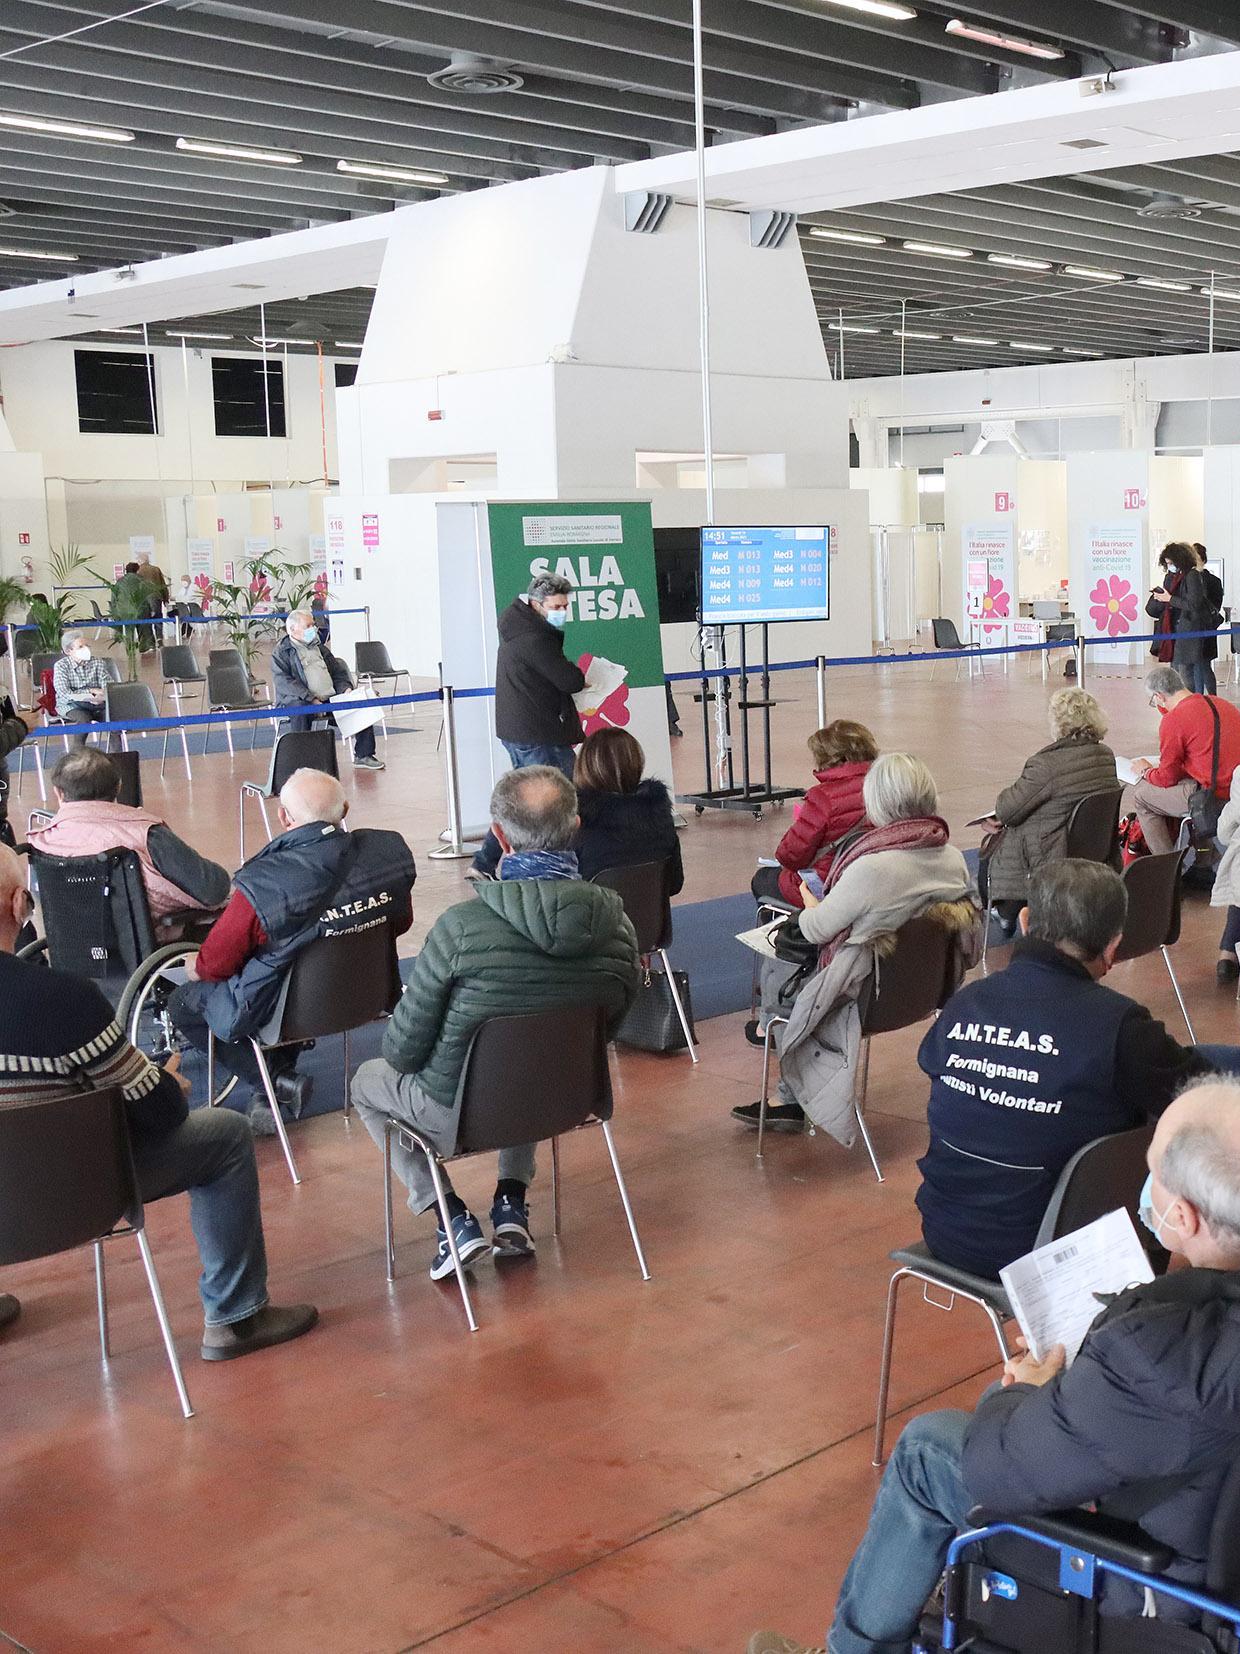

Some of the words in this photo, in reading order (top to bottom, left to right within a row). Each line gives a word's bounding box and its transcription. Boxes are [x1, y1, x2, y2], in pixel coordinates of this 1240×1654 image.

[999, 496, 1006, 510] 9
[1126, 493, 1139, 507] 10
[330, 520, 343, 530] 118
[705, 531, 725, 541] 14:51
[712, 551, 728, 560] Med
[774, 550, 793, 559] Med3
[530, 556, 624, 587] SALA
[710, 566, 730, 575] Med3
[774, 564, 794, 574] Med4
[710, 580, 731, 589] Med4
[774, 579, 794, 588] Med4
[710, 595, 731, 604] Med4
[974, 597, 979, 607] 1
[325, 915, 387, 937] Formignana
[947, 1022, 1060, 1055] A.N.T.E.A.S.
[946, 1054, 1039, 1083] Formignana
[978, 1087, 1063, 1114] Volontari
